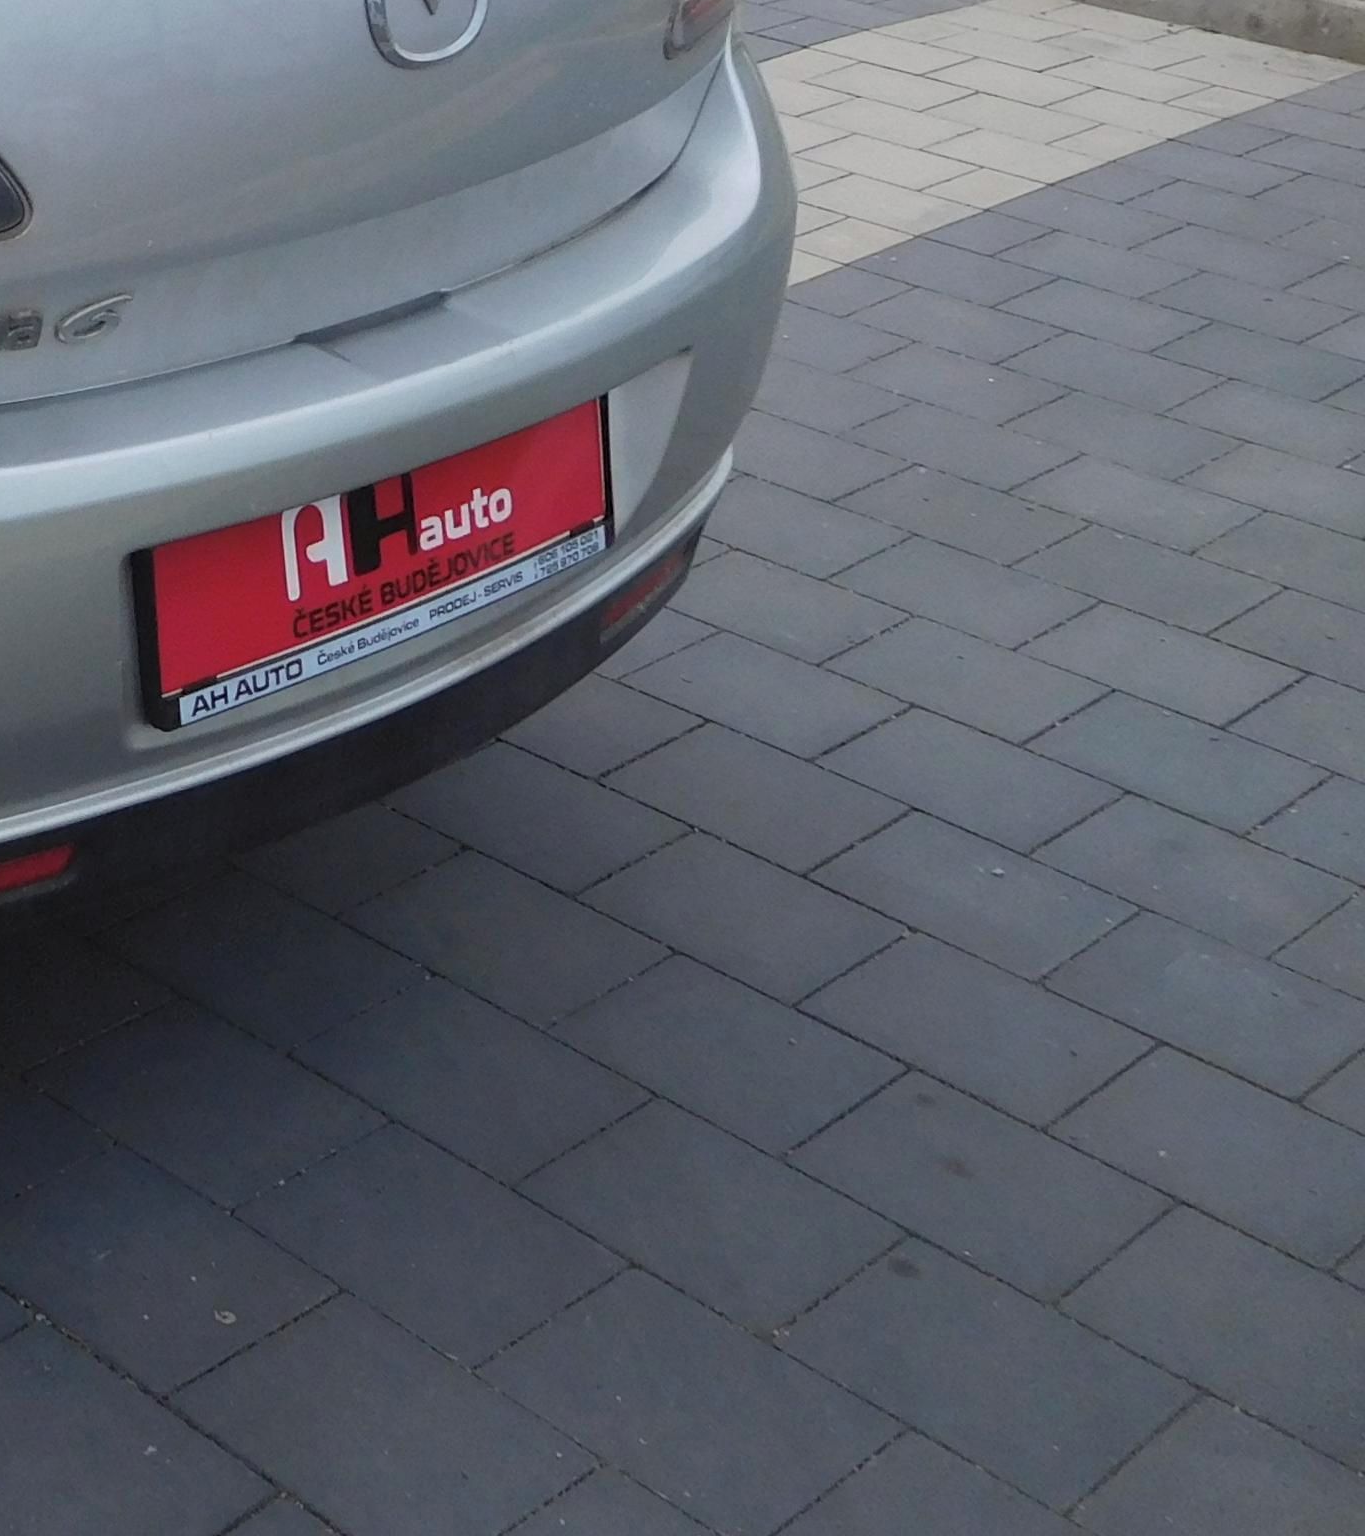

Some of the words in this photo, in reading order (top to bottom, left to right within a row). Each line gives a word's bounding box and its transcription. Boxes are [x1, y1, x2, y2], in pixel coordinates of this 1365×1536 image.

[420, 487, 513, 551] auto
[292, 585, 374, 639] ČESKÉ
[381, 532, 516, 607] BUDĚJOVICE
[191, 684, 229, 717] AH
[234, 658, 303, 701] AUTO
[317, 640, 355, 666] České
[357, 617, 419, 651] Budějovice
